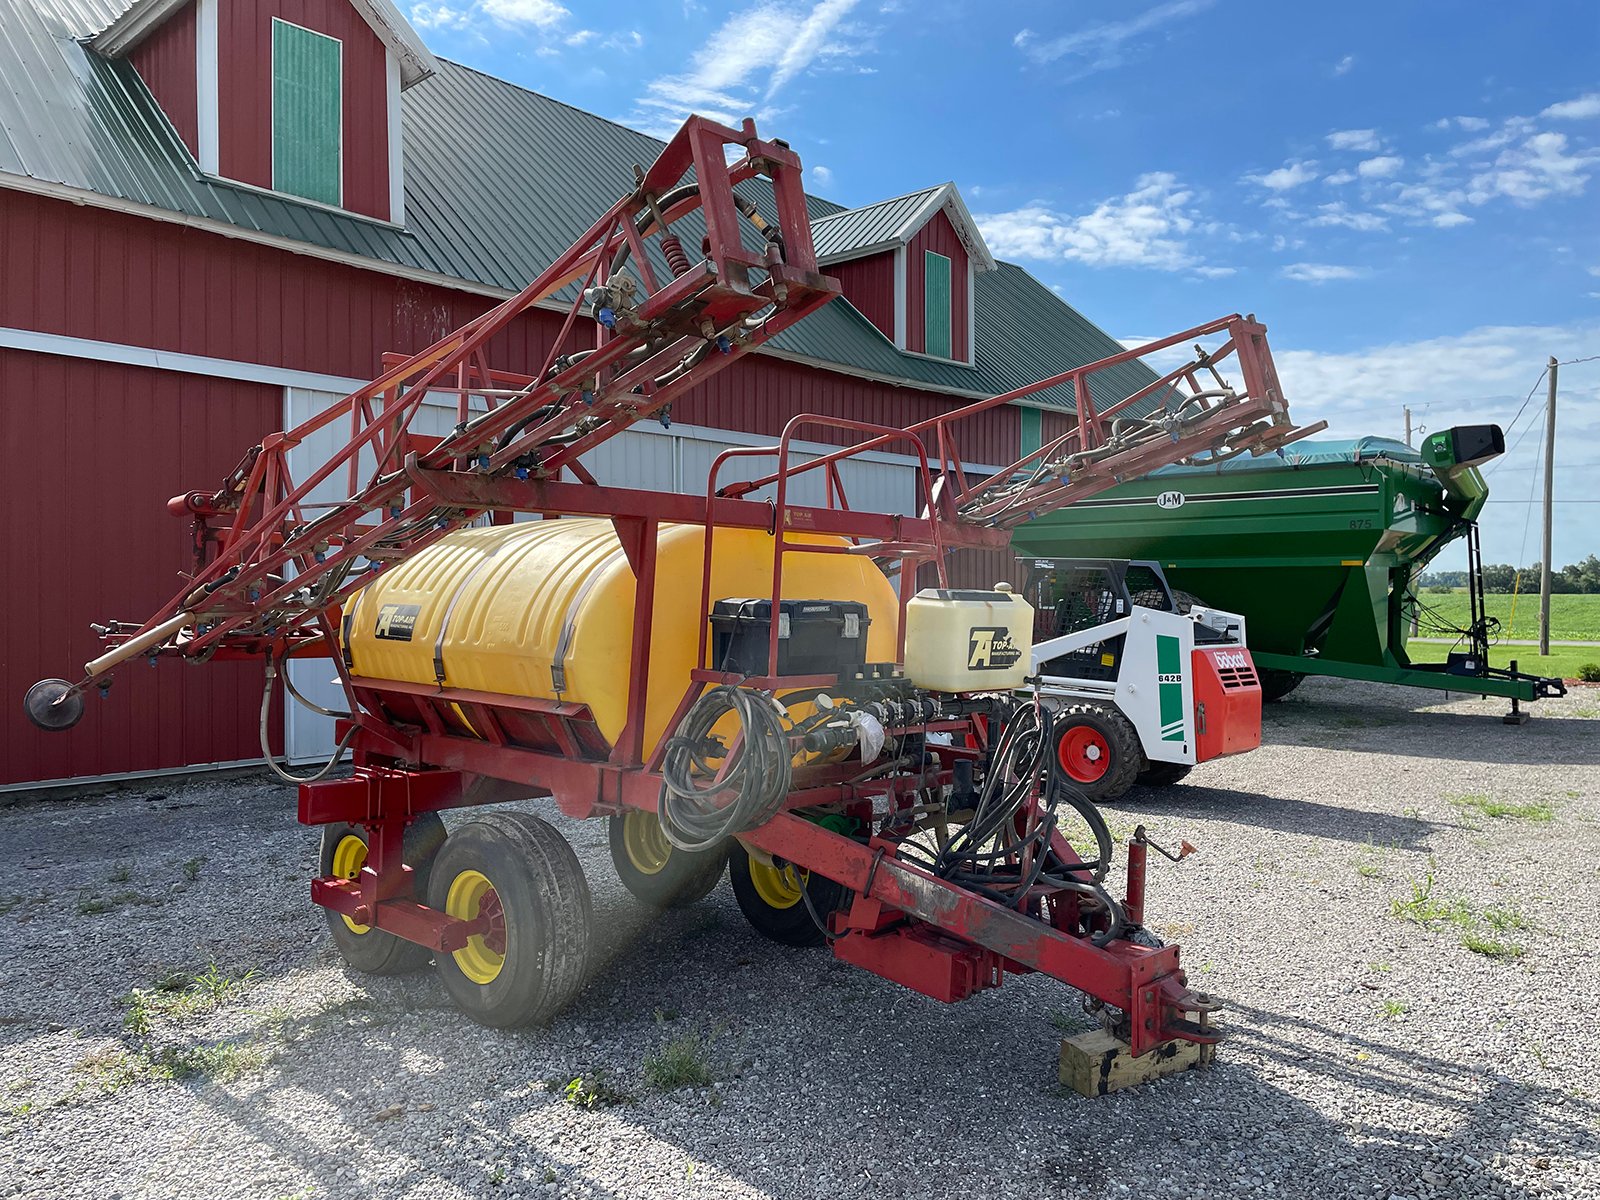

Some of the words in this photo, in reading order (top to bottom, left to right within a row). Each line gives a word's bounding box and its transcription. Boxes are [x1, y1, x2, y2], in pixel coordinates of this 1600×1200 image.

[1159, 493, 1181, 506] J&M
[1350, 519, 1372, 529] 875
[992, 641, 1017, 650] TOP-A
[1213, 651, 1247, 669] bobcat
[1158, 674, 1182, 683] 642B
